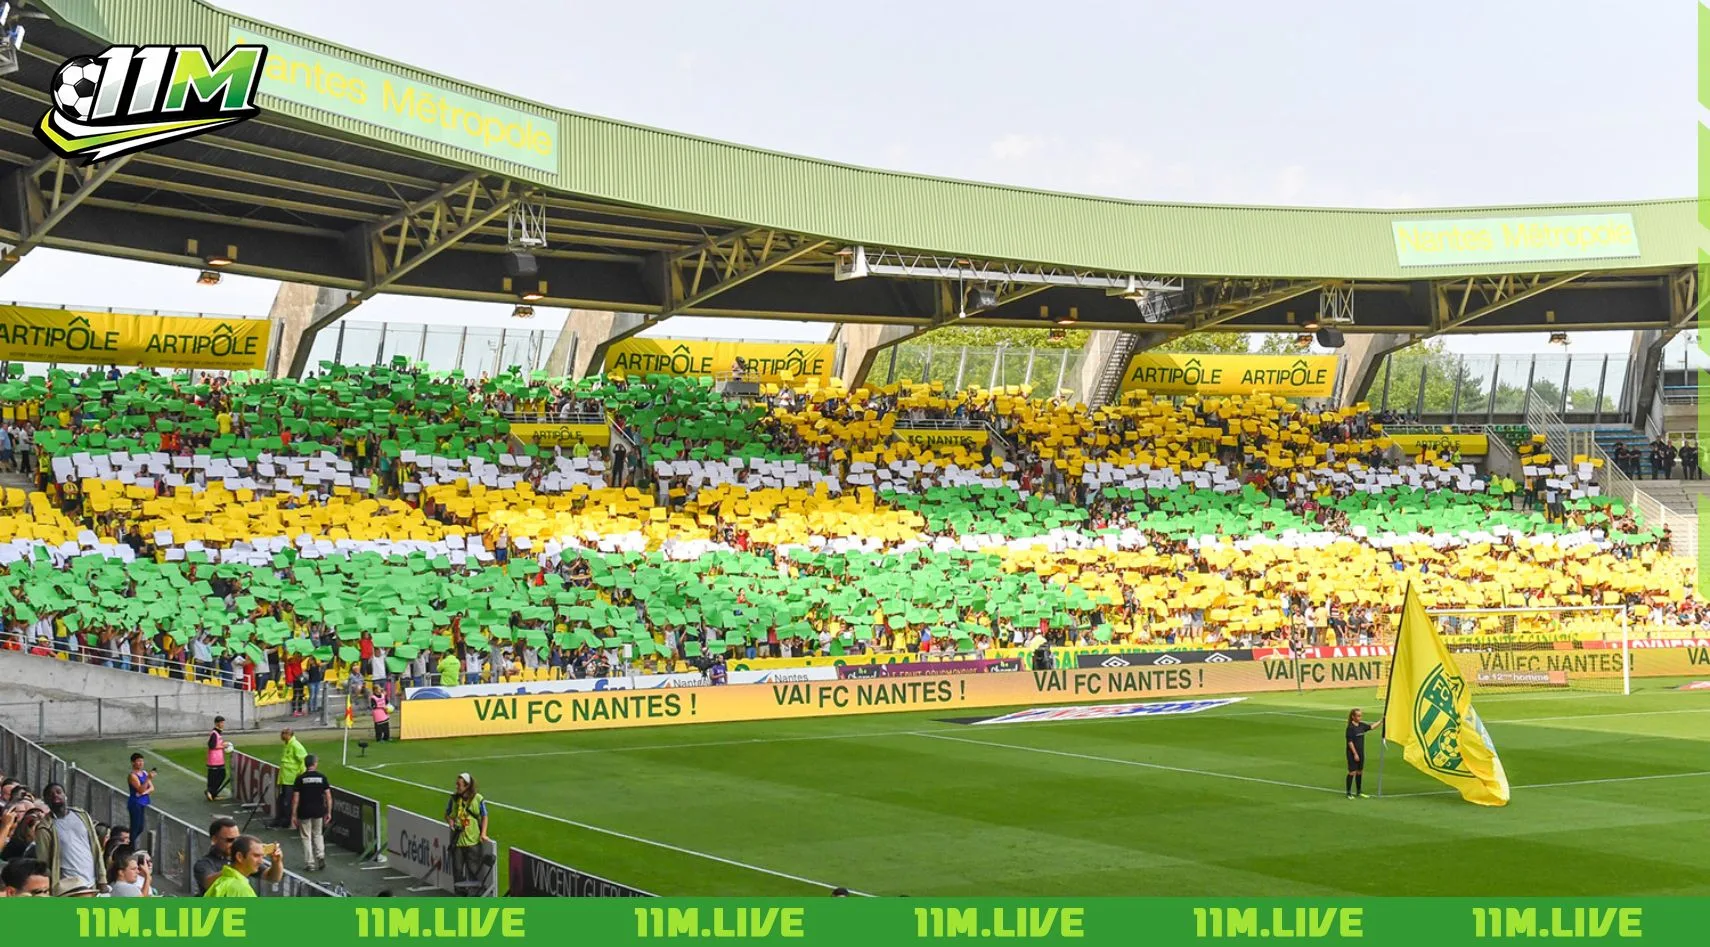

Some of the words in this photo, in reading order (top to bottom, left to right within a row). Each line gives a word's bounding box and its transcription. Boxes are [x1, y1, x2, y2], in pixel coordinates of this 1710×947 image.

[246, 43, 368, 104] antes
[1399, 224, 1494, 252] Nantes
[145, 323, 259, 356] ARTIPÔLE
[614, 344, 713, 374] ARTIPÔLE
[742, 348, 824, 376] RTIPÔLE
[1132, 358, 1223, 386] ARTIPÔLE
[1241, 359, 1327, 387] ARTIPÔLE
[533, 426, 582, 441] ARTIPÔLE
[1547, 654, 1623, 673] NANTES
[1687, 647, 1710, 665] VA
[774, 674, 808, 683] Nantes
[1034, 670, 1067, 692] VAI
[1074, 673, 1101, 695] FC
[1108, 668, 1192, 693] NANTES
[1263, 660, 1294, 681] VAI
[1300, 663, 1325, 683] FC
[773, 684, 811, 706] VAI
[818, 685, 849, 708] FC
[857, 680, 952, 706] NANTES
[474, 698, 518, 721] VAI
[528, 700, 563, 724] FC
[572, 694, 681, 722] NANTES
[400, 829, 430, 868] Crédit
